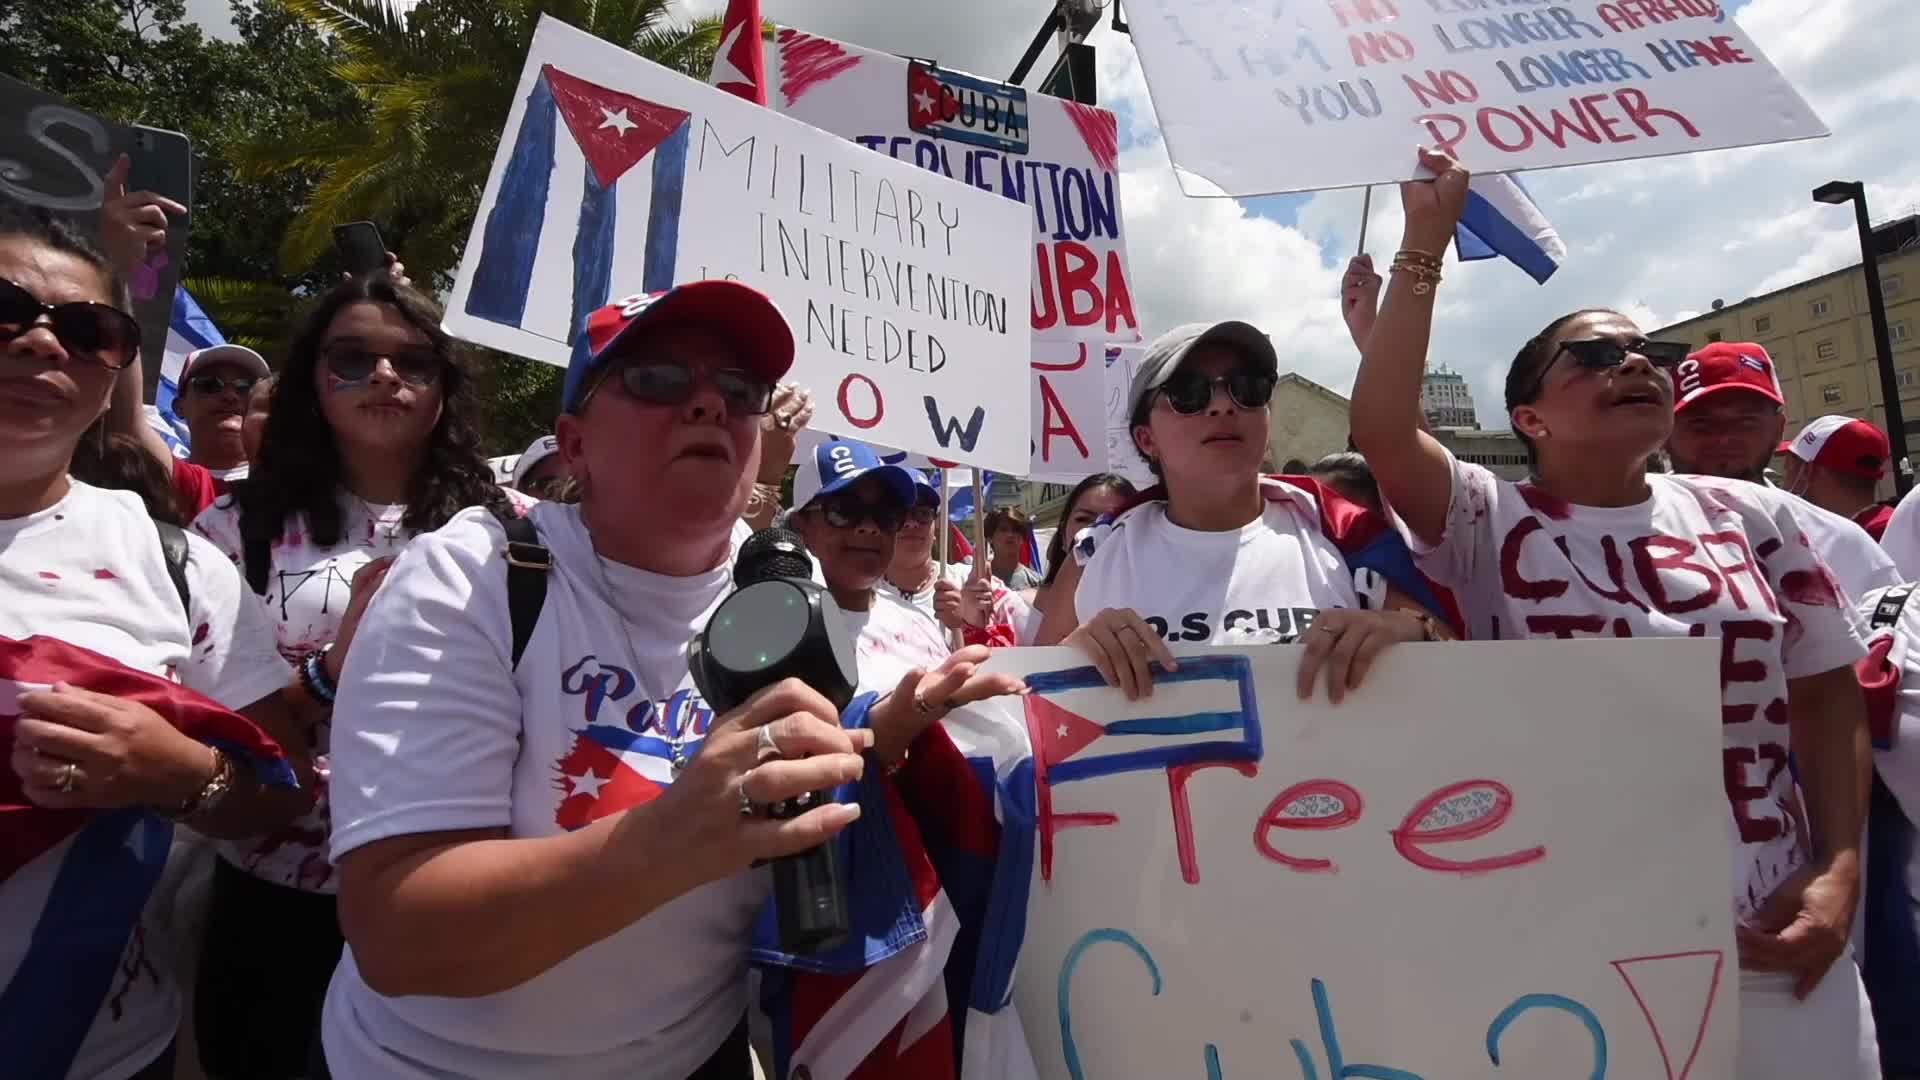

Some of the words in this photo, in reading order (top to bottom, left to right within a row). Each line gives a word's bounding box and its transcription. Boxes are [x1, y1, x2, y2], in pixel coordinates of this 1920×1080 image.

[1347, 30, 1416, 67] NO
[1434, 5, 1604, 54] LONGER
[938, 82, 1020, 139] CUBA
[1273, 77, 1383, 125] YOU
[1402, 68, 1479, 108] NO
[1496, 47, 1653, 94] LONGER
[1412, 87, 1701, 163] POWER
[698, 117, 962, 256] MILITARY
[753, 211, 1009, 334] INTERVENTION
[1031, 240, 1137, 333] UBA
[806, 298, 946, 374] NEEDED
[1500, 516, 1778, 615] CUBA
